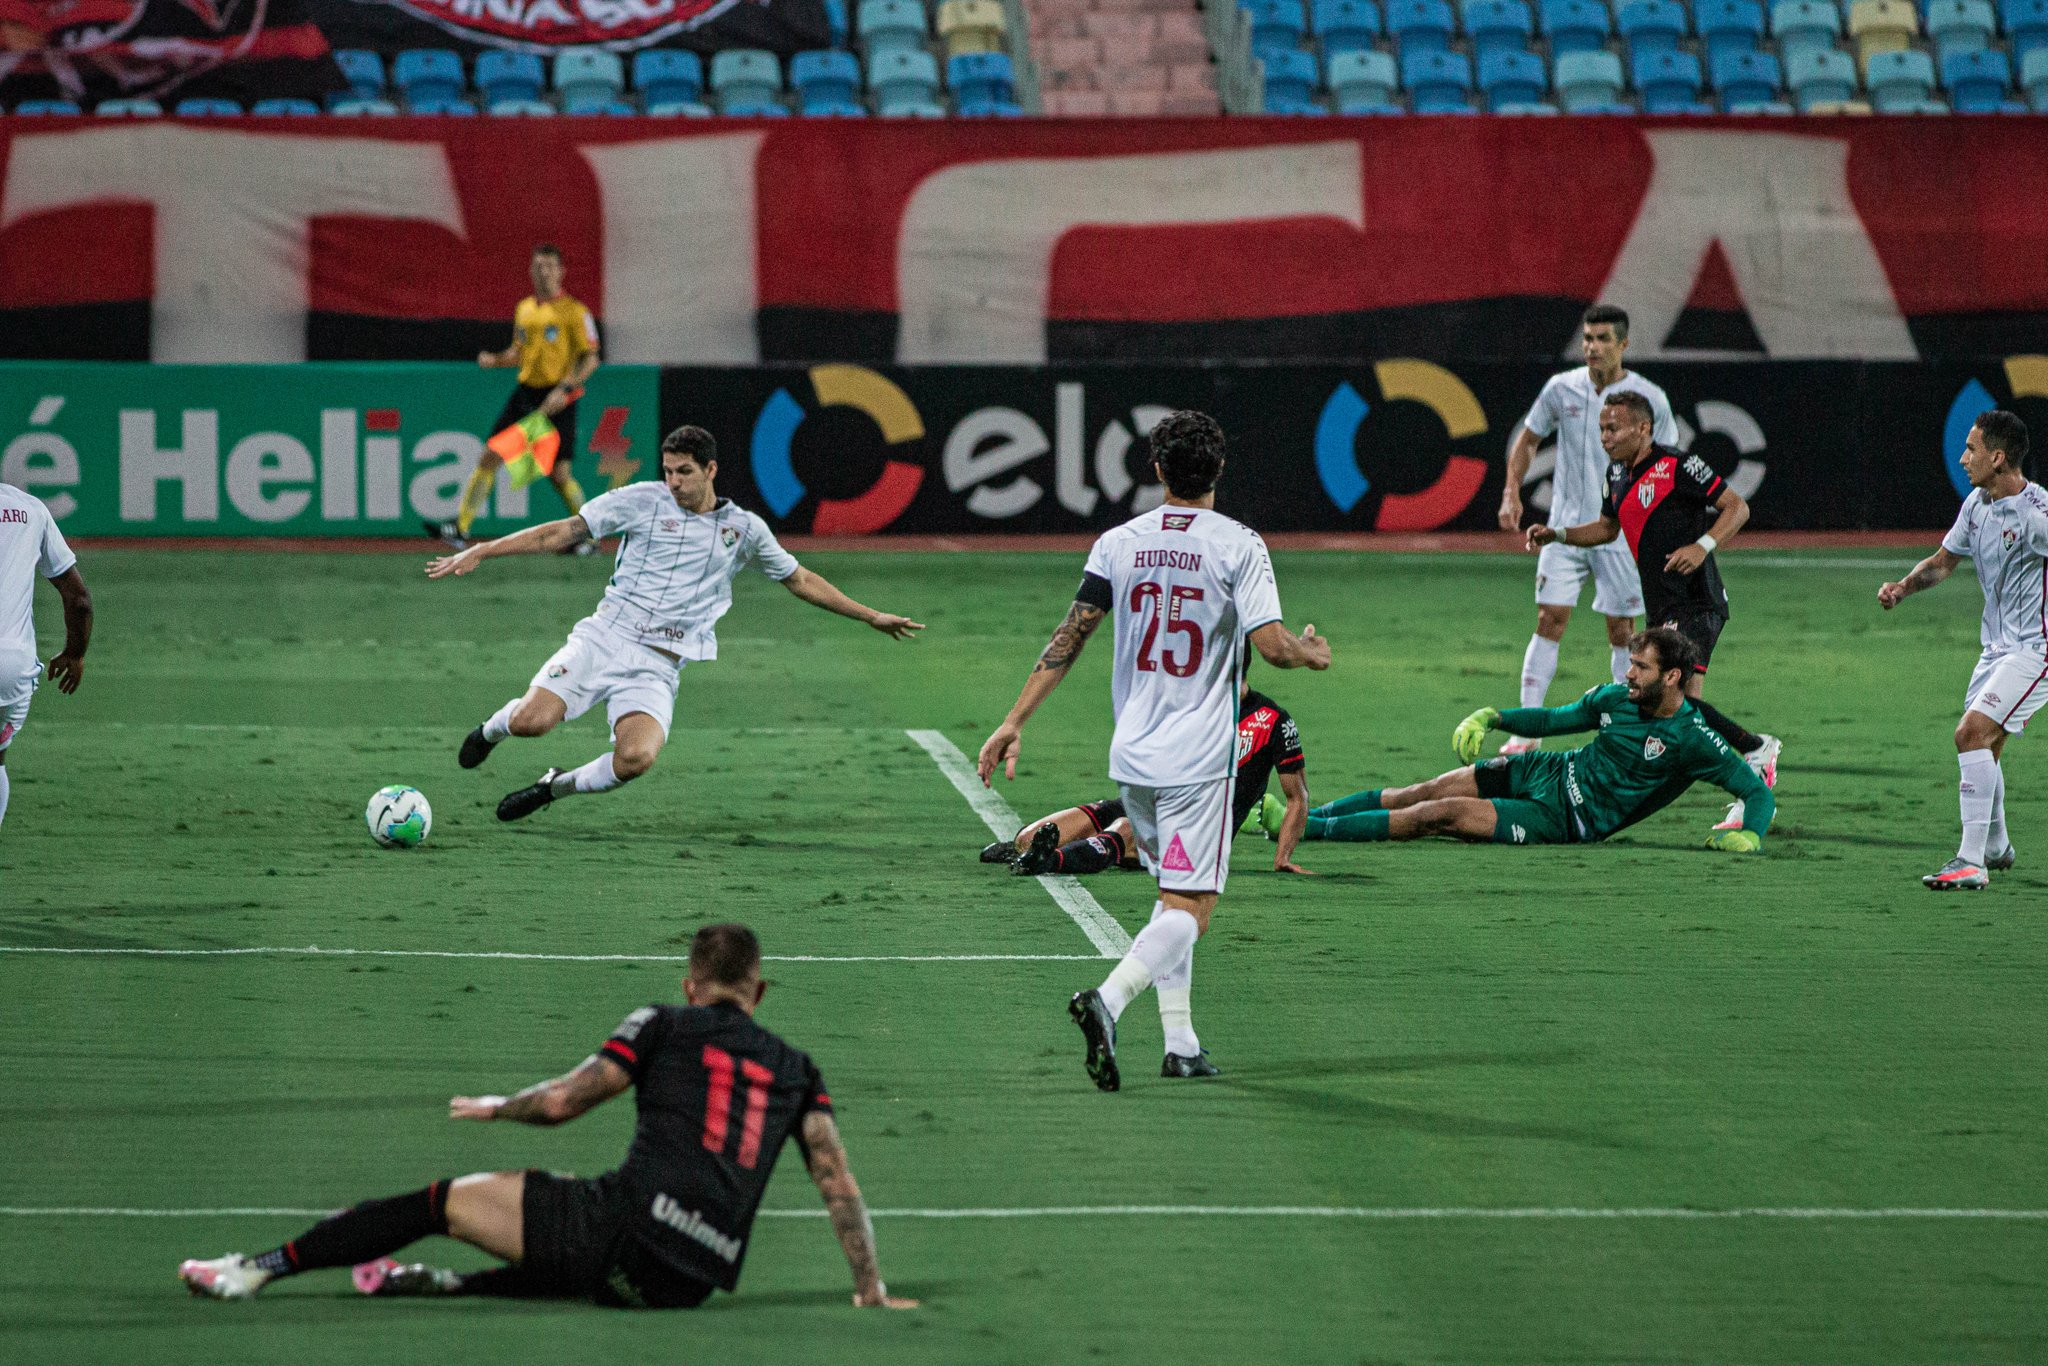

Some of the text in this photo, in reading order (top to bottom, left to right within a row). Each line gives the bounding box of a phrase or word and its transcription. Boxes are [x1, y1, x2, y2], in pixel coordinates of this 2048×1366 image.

[0, 508, 28, 524] ARO
[1133, 549, 1202, 572] HUDSON
[1130, 581, 1204, 678] 25
[702, 1042, 775, 1170] 11
[651, 1191, 742, 1264] Unimed
